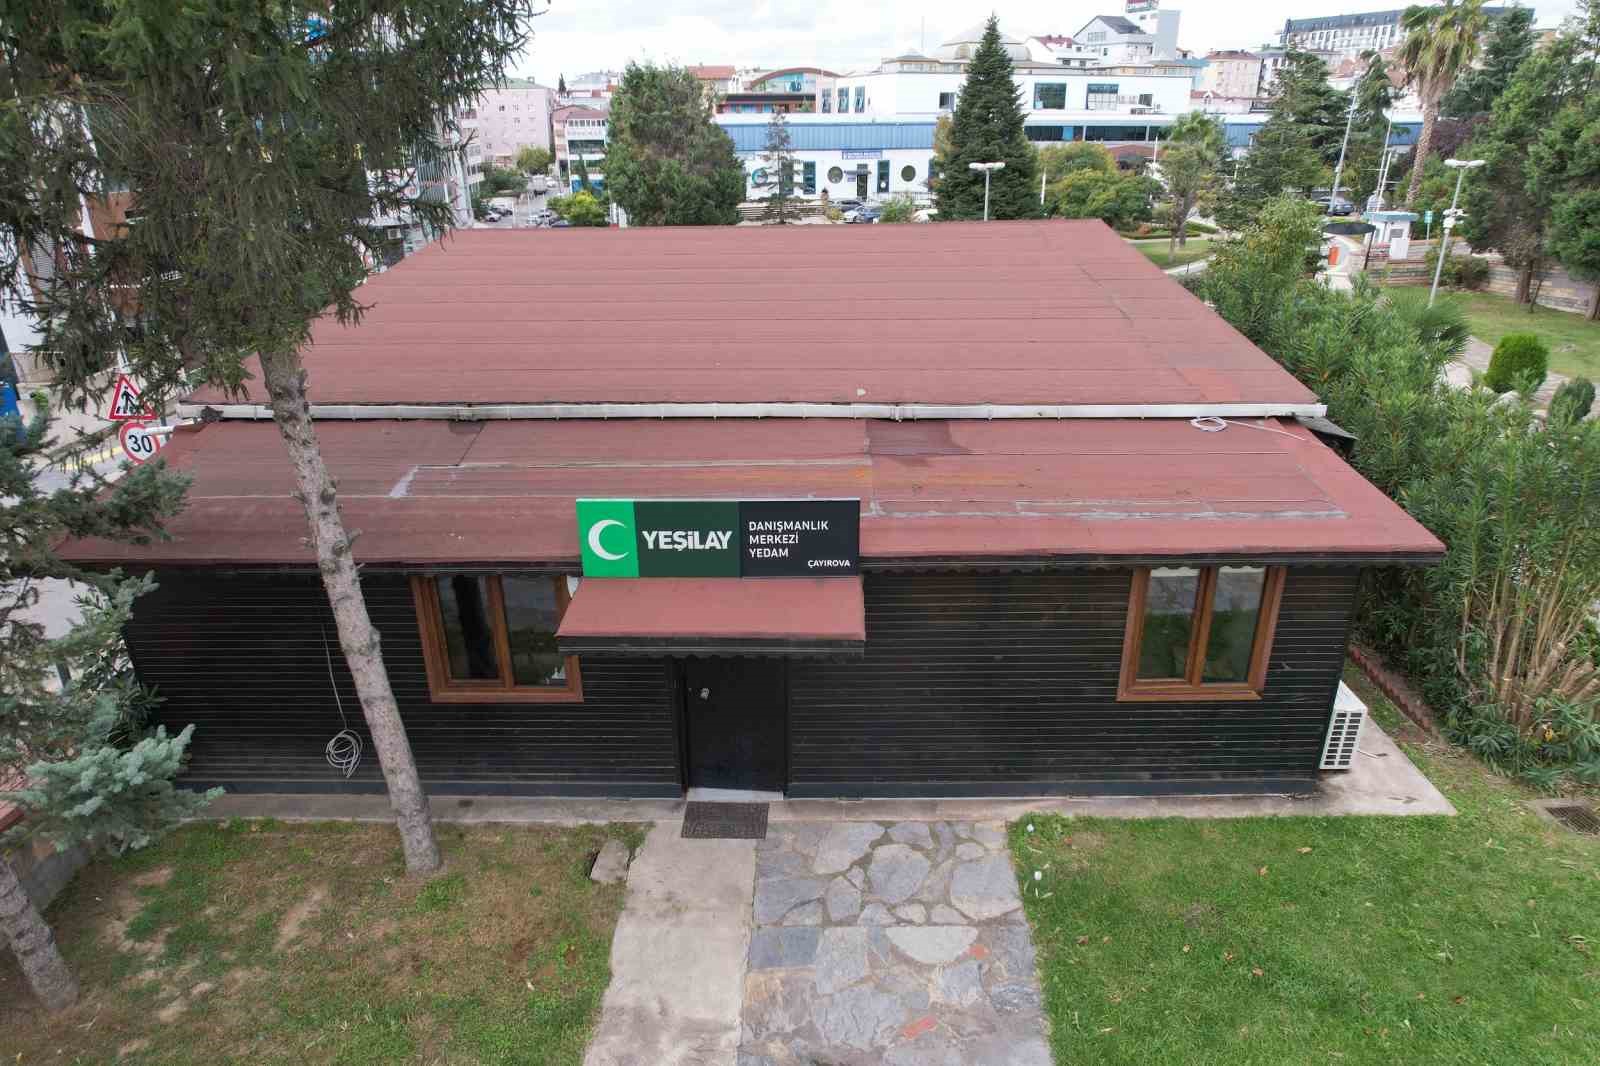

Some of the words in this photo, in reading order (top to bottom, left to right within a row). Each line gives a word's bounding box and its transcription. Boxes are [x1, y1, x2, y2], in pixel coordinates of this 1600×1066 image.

[128, 434, 153, 453] 30
[748, 520, 829, 533] DANIŞMANLIK
[749, 531, 799, 545] MERKEZİ
[748, 548, 789, 558] YEDAM
[807, 559, 851, 569] ÇAYIROVA
